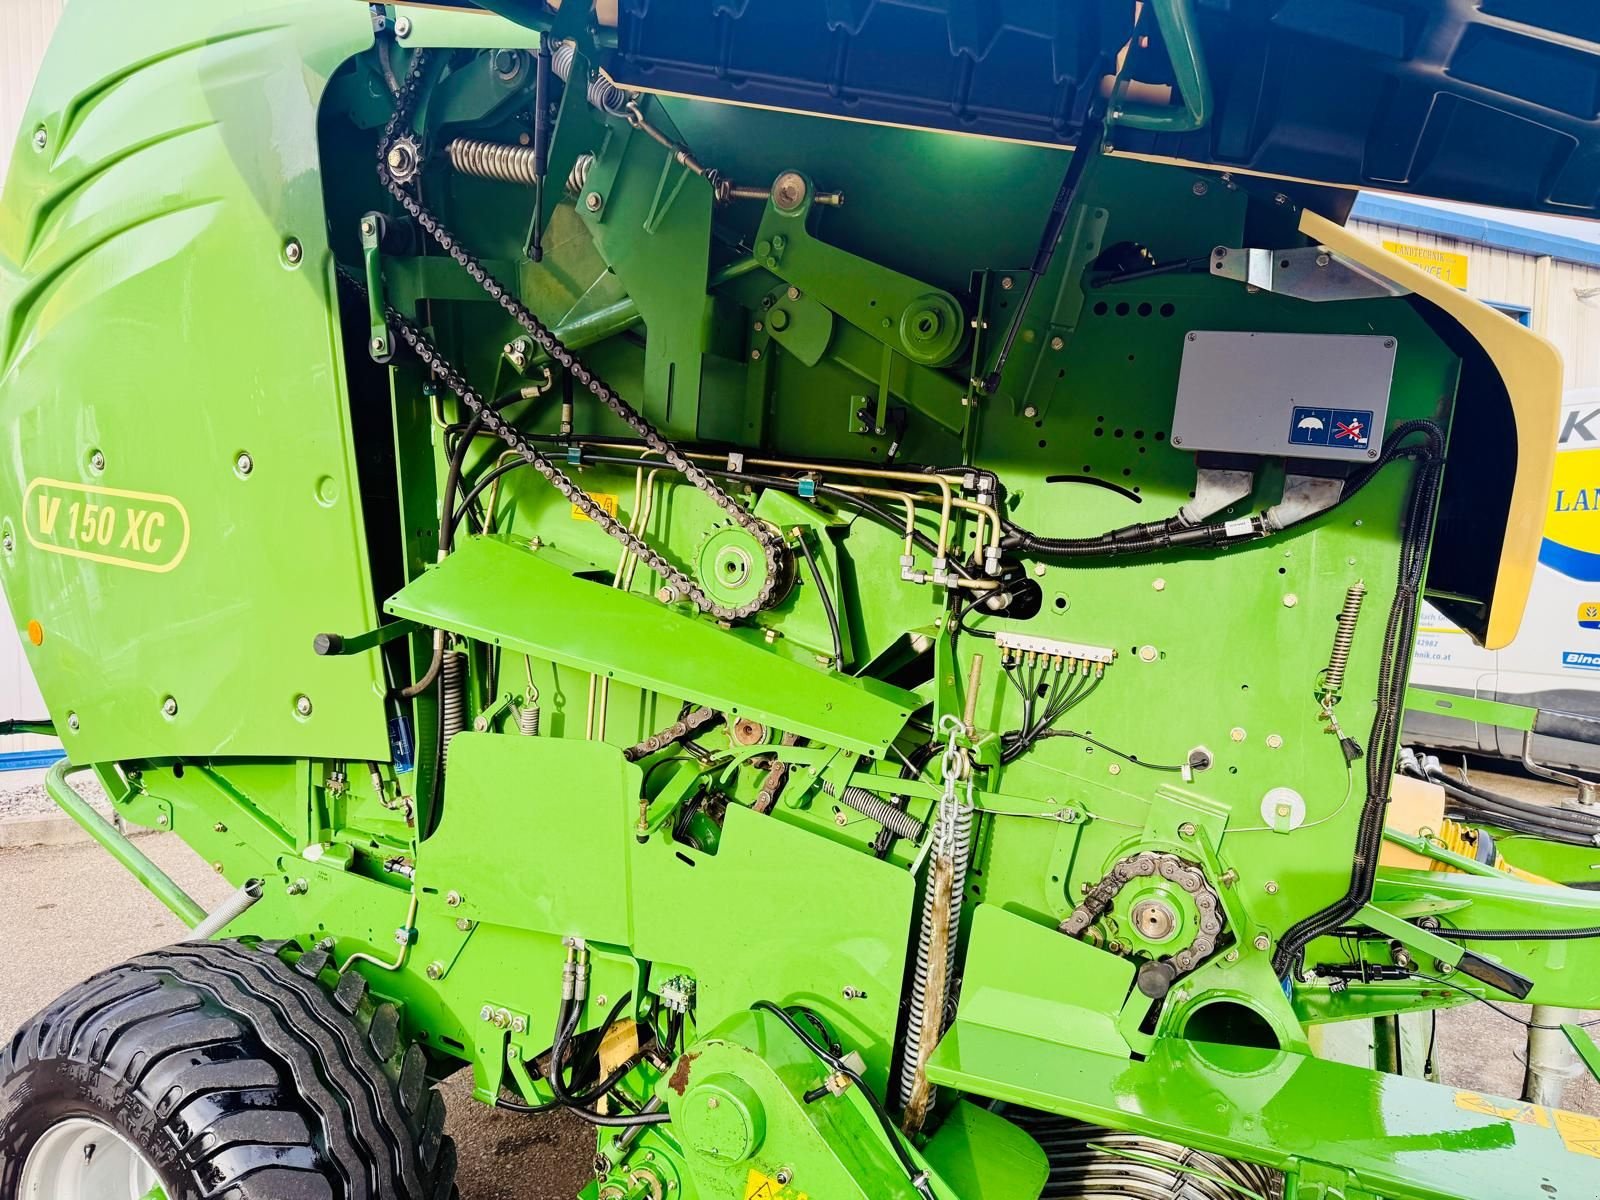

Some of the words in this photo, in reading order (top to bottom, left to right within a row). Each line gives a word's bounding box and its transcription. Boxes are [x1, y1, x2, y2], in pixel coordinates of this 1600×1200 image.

[1396, 245, 1444, 262] LANDTECHNIK
[38, 495, 62, 535] V
[70, 502, 116, 546] 150
[120, 509, 166, 554] XC
